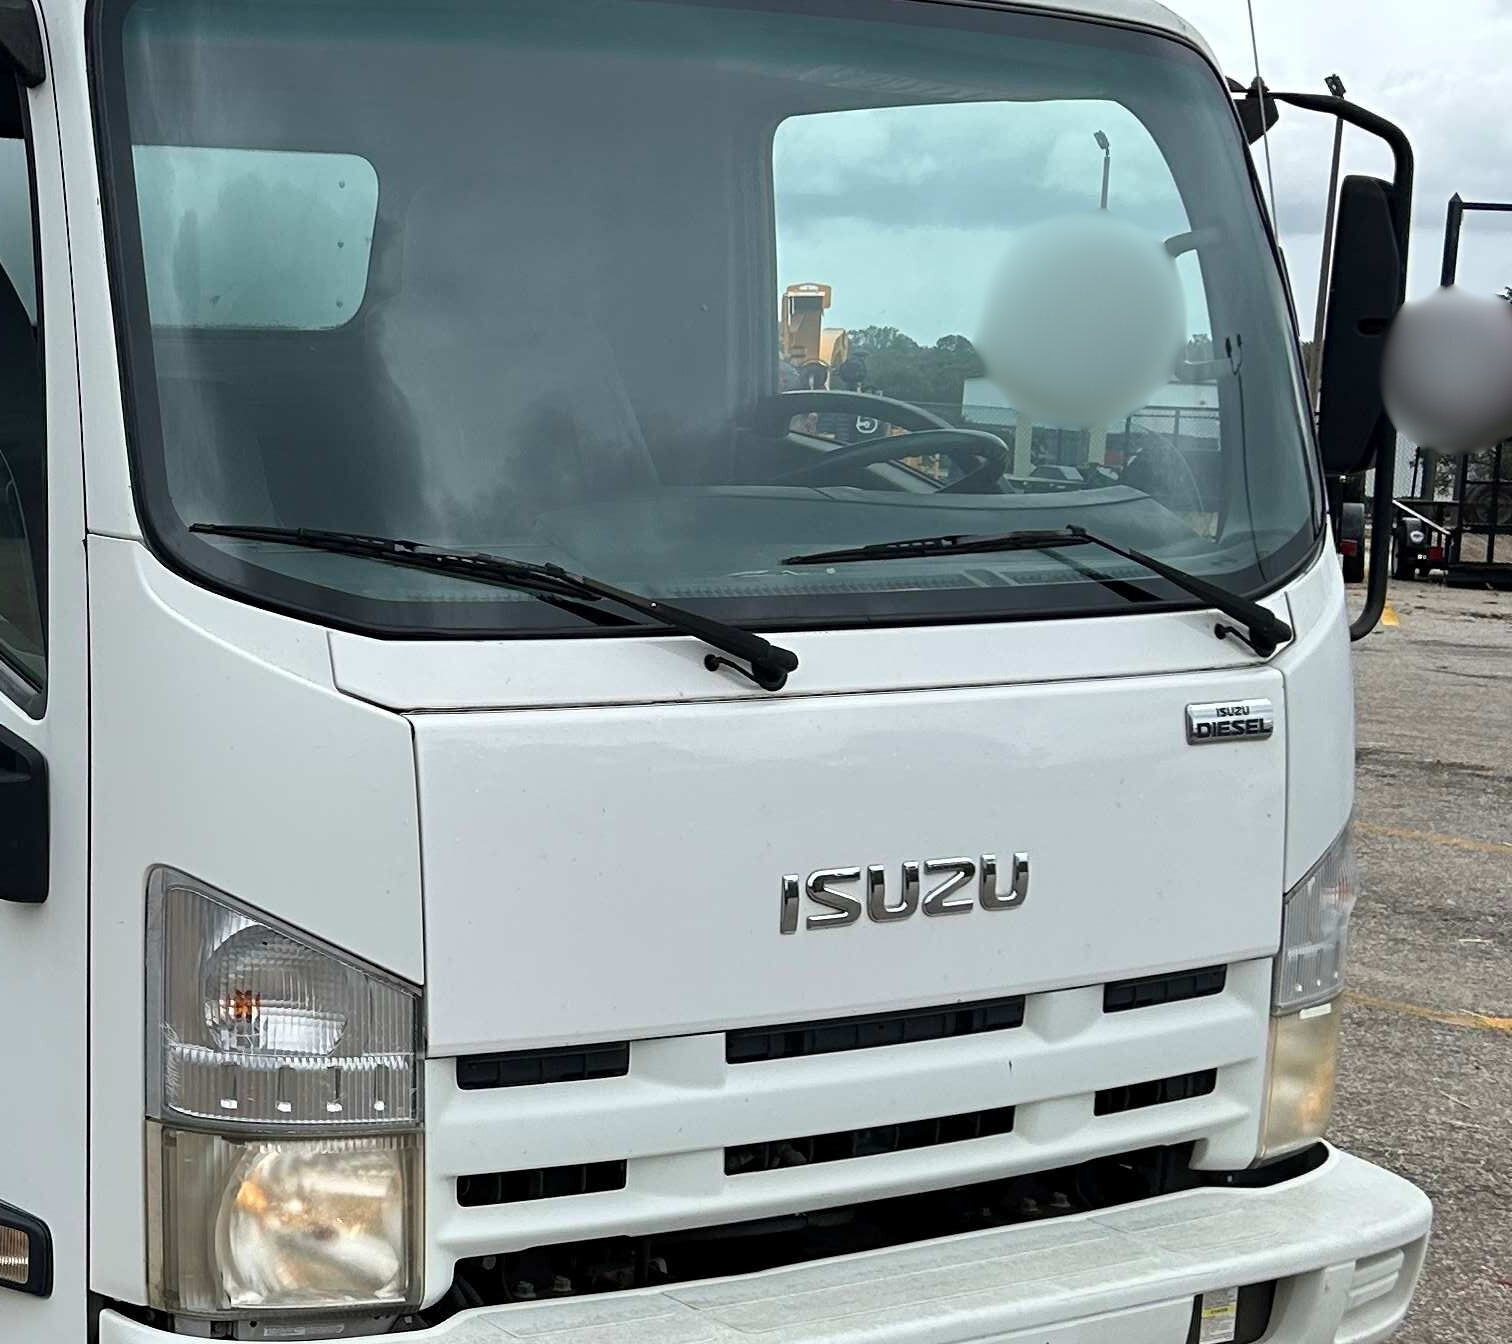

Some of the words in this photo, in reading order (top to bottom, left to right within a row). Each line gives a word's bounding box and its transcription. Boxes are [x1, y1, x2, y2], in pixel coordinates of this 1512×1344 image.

[1216, 706, 1250, 717] ISUZU
[1195, 718, 1273, 738] DIESEL
[780, 852, 1029, 935] ISUZU
